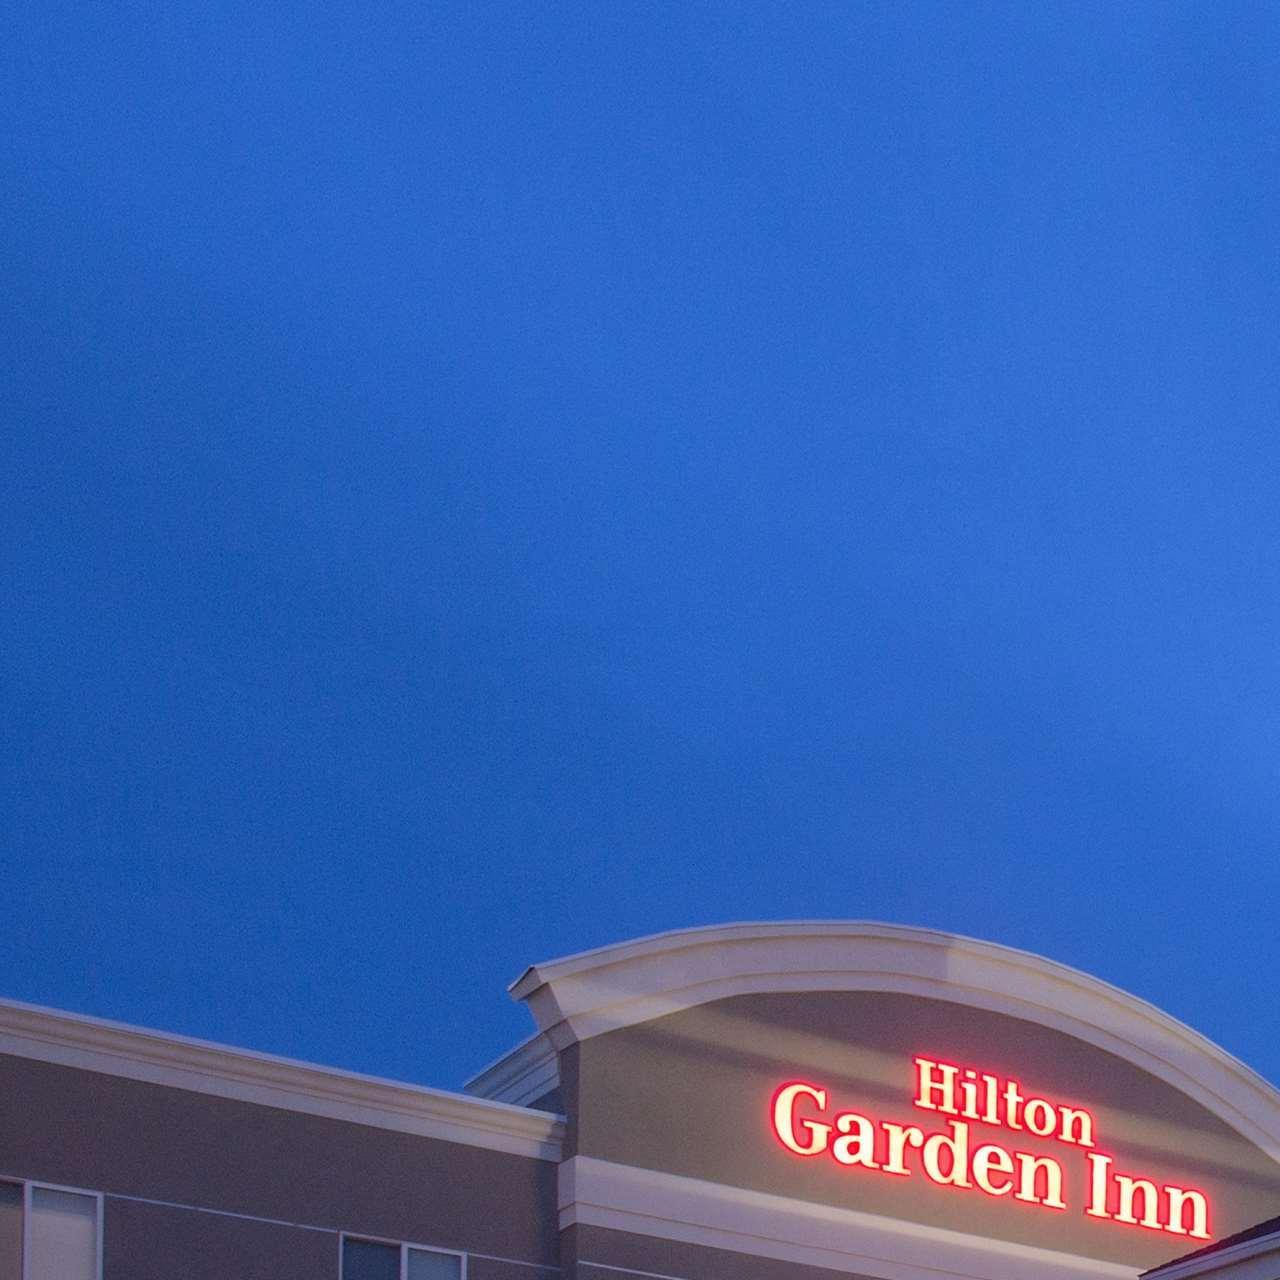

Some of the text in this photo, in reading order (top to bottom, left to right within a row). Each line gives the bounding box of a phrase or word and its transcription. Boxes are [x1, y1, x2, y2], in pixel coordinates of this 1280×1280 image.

[771, 1081, 1213, 1240] Garden Inn
[913, 1056, 1096, 1149] Hilton
